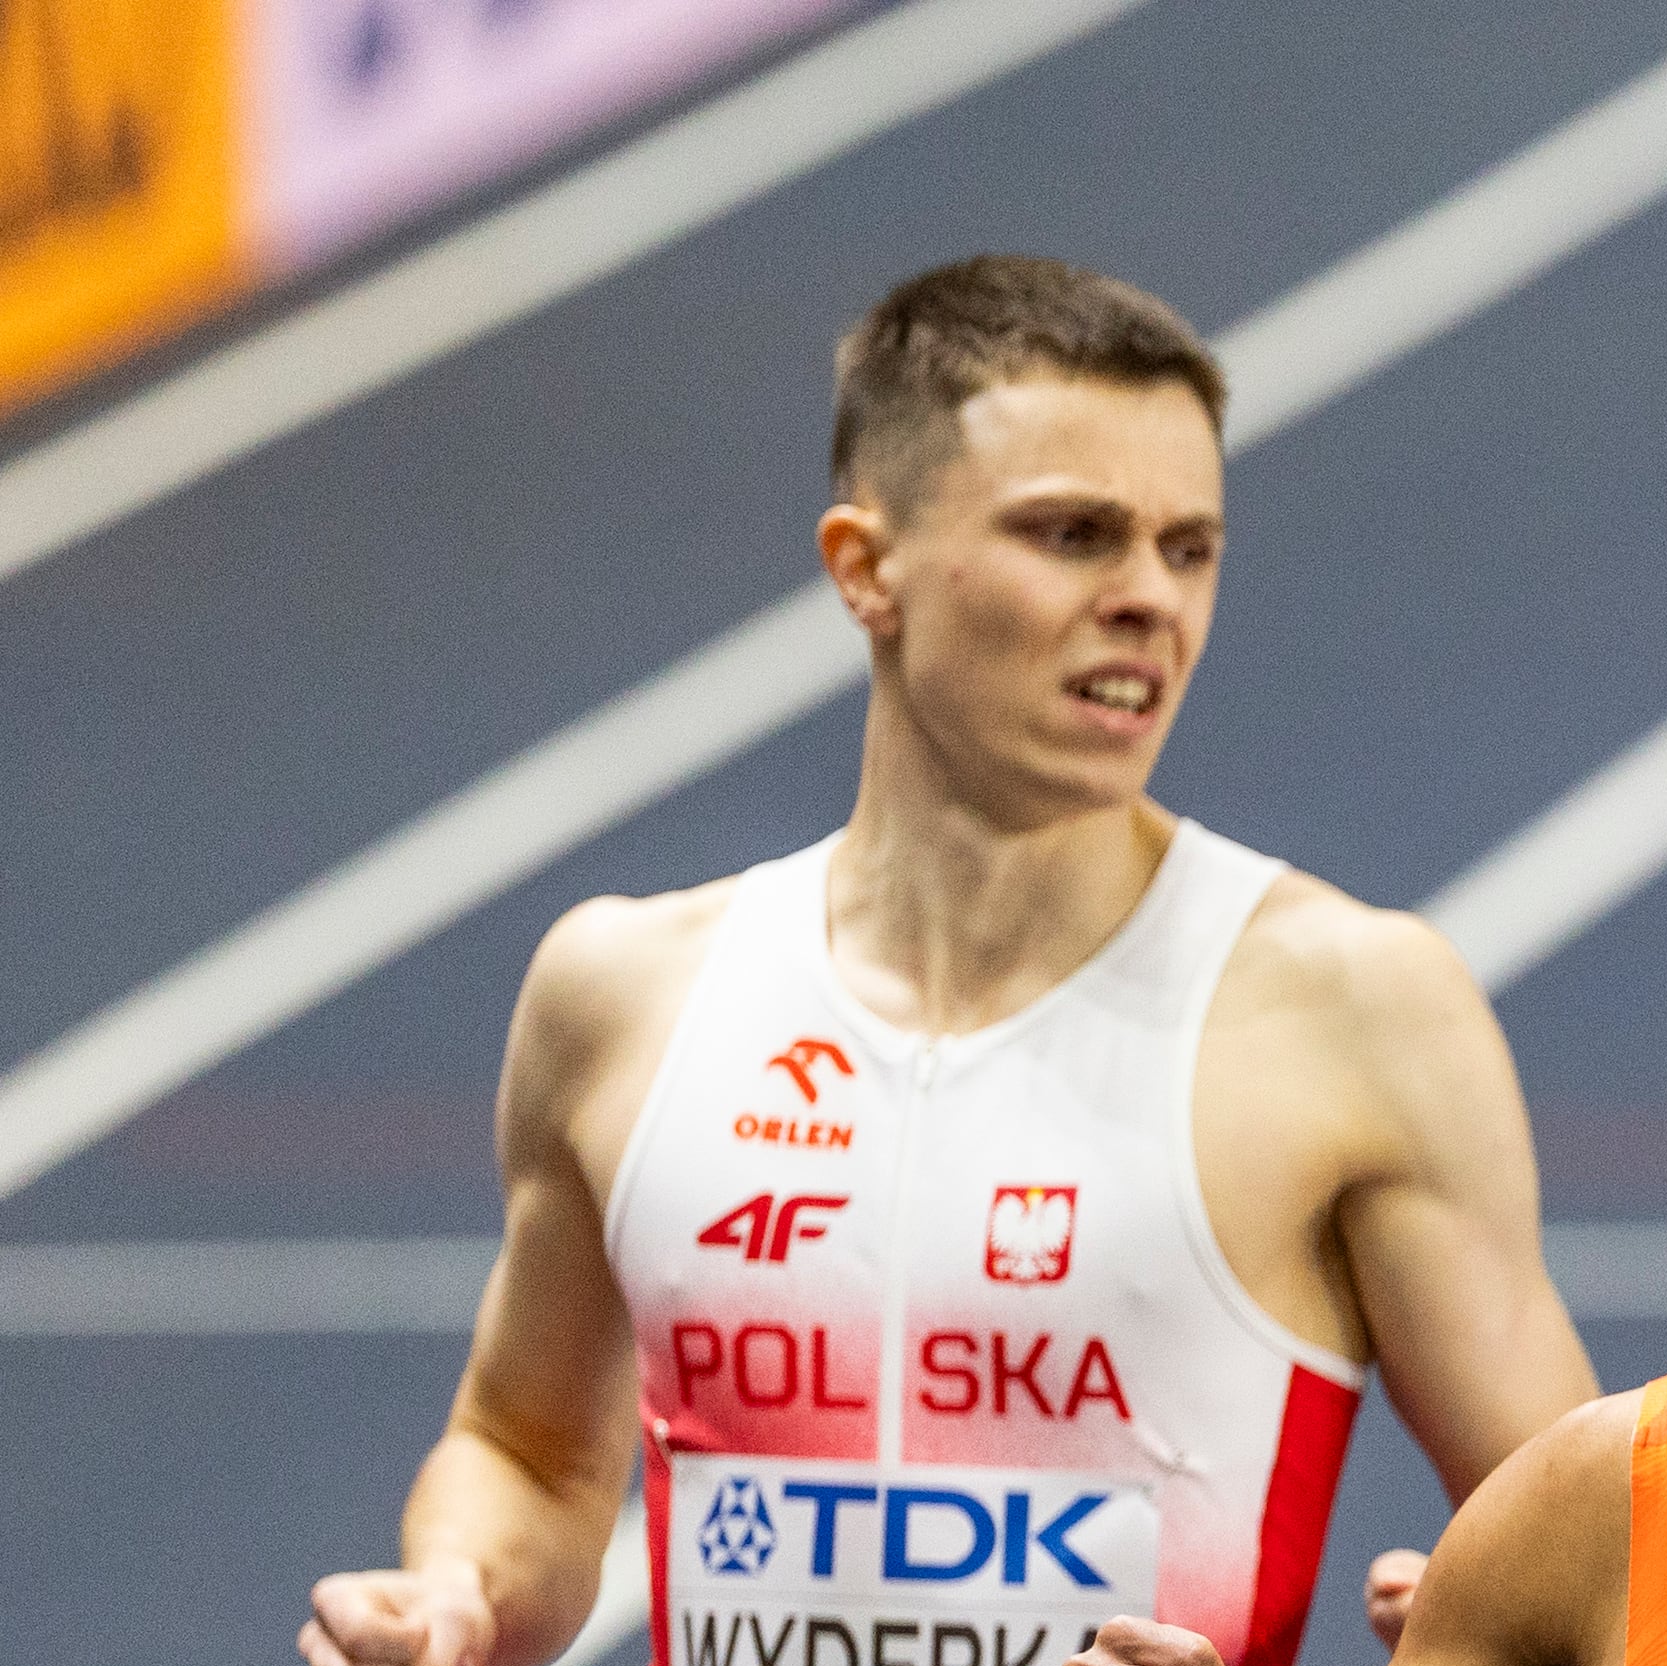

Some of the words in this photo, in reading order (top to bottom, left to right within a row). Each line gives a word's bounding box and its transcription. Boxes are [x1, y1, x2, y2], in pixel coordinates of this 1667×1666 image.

[735, 1115, 852, 1149] ORLEN
[697, 1193, 851, 1262] 4F
[672, 1322, 1131, 1420] POLSKA
[784, 1483, 1110, 1589] TDK
